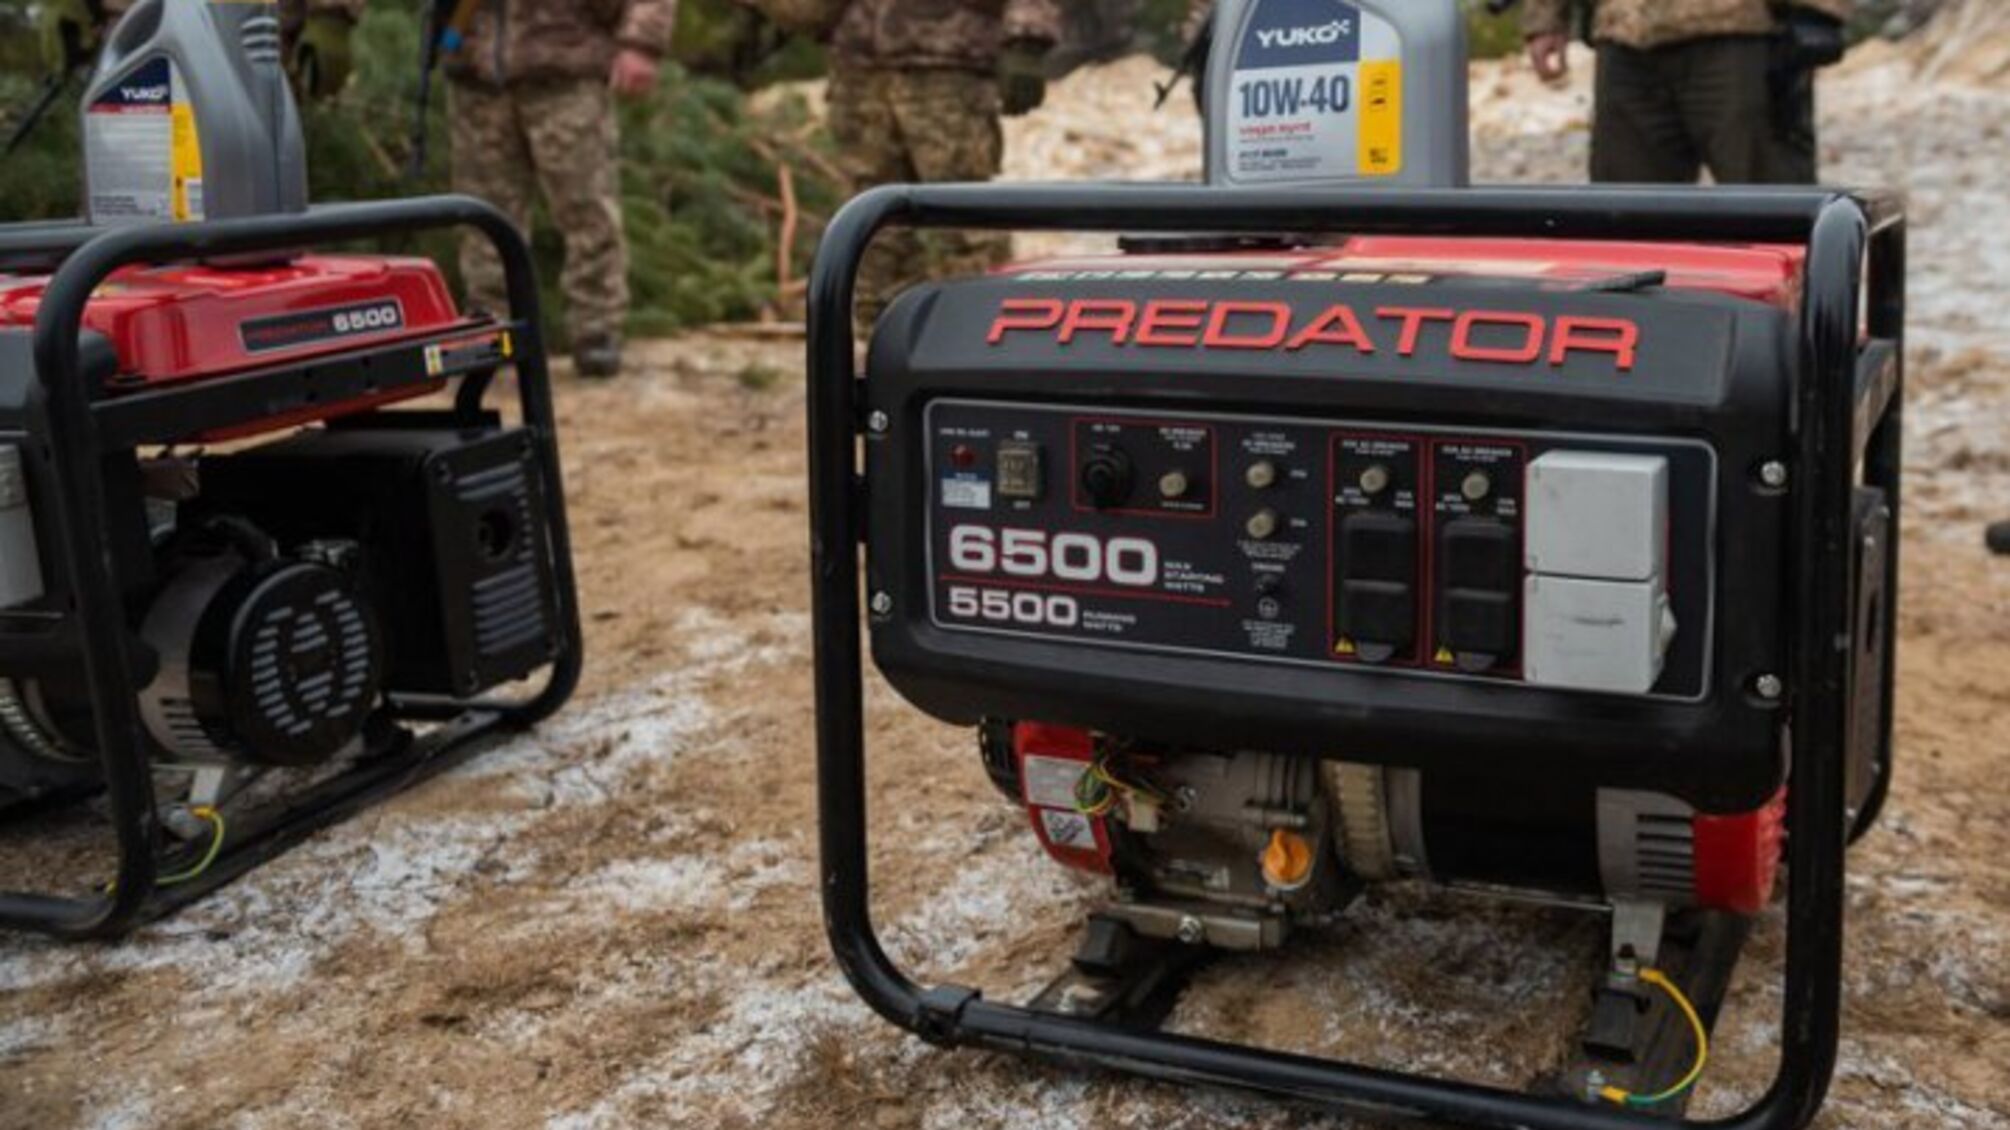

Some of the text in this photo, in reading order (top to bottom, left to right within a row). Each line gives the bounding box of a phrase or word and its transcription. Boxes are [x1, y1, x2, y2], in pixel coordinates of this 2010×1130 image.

[1239, 75, 1350, 118] 10W-40
[332, 304, 397, 332] 6500
[987, 298, 1640, 369] PREDATOR
[949, 524, 1158, 586] 6500
[948, 586, 1078, 626] 5500
